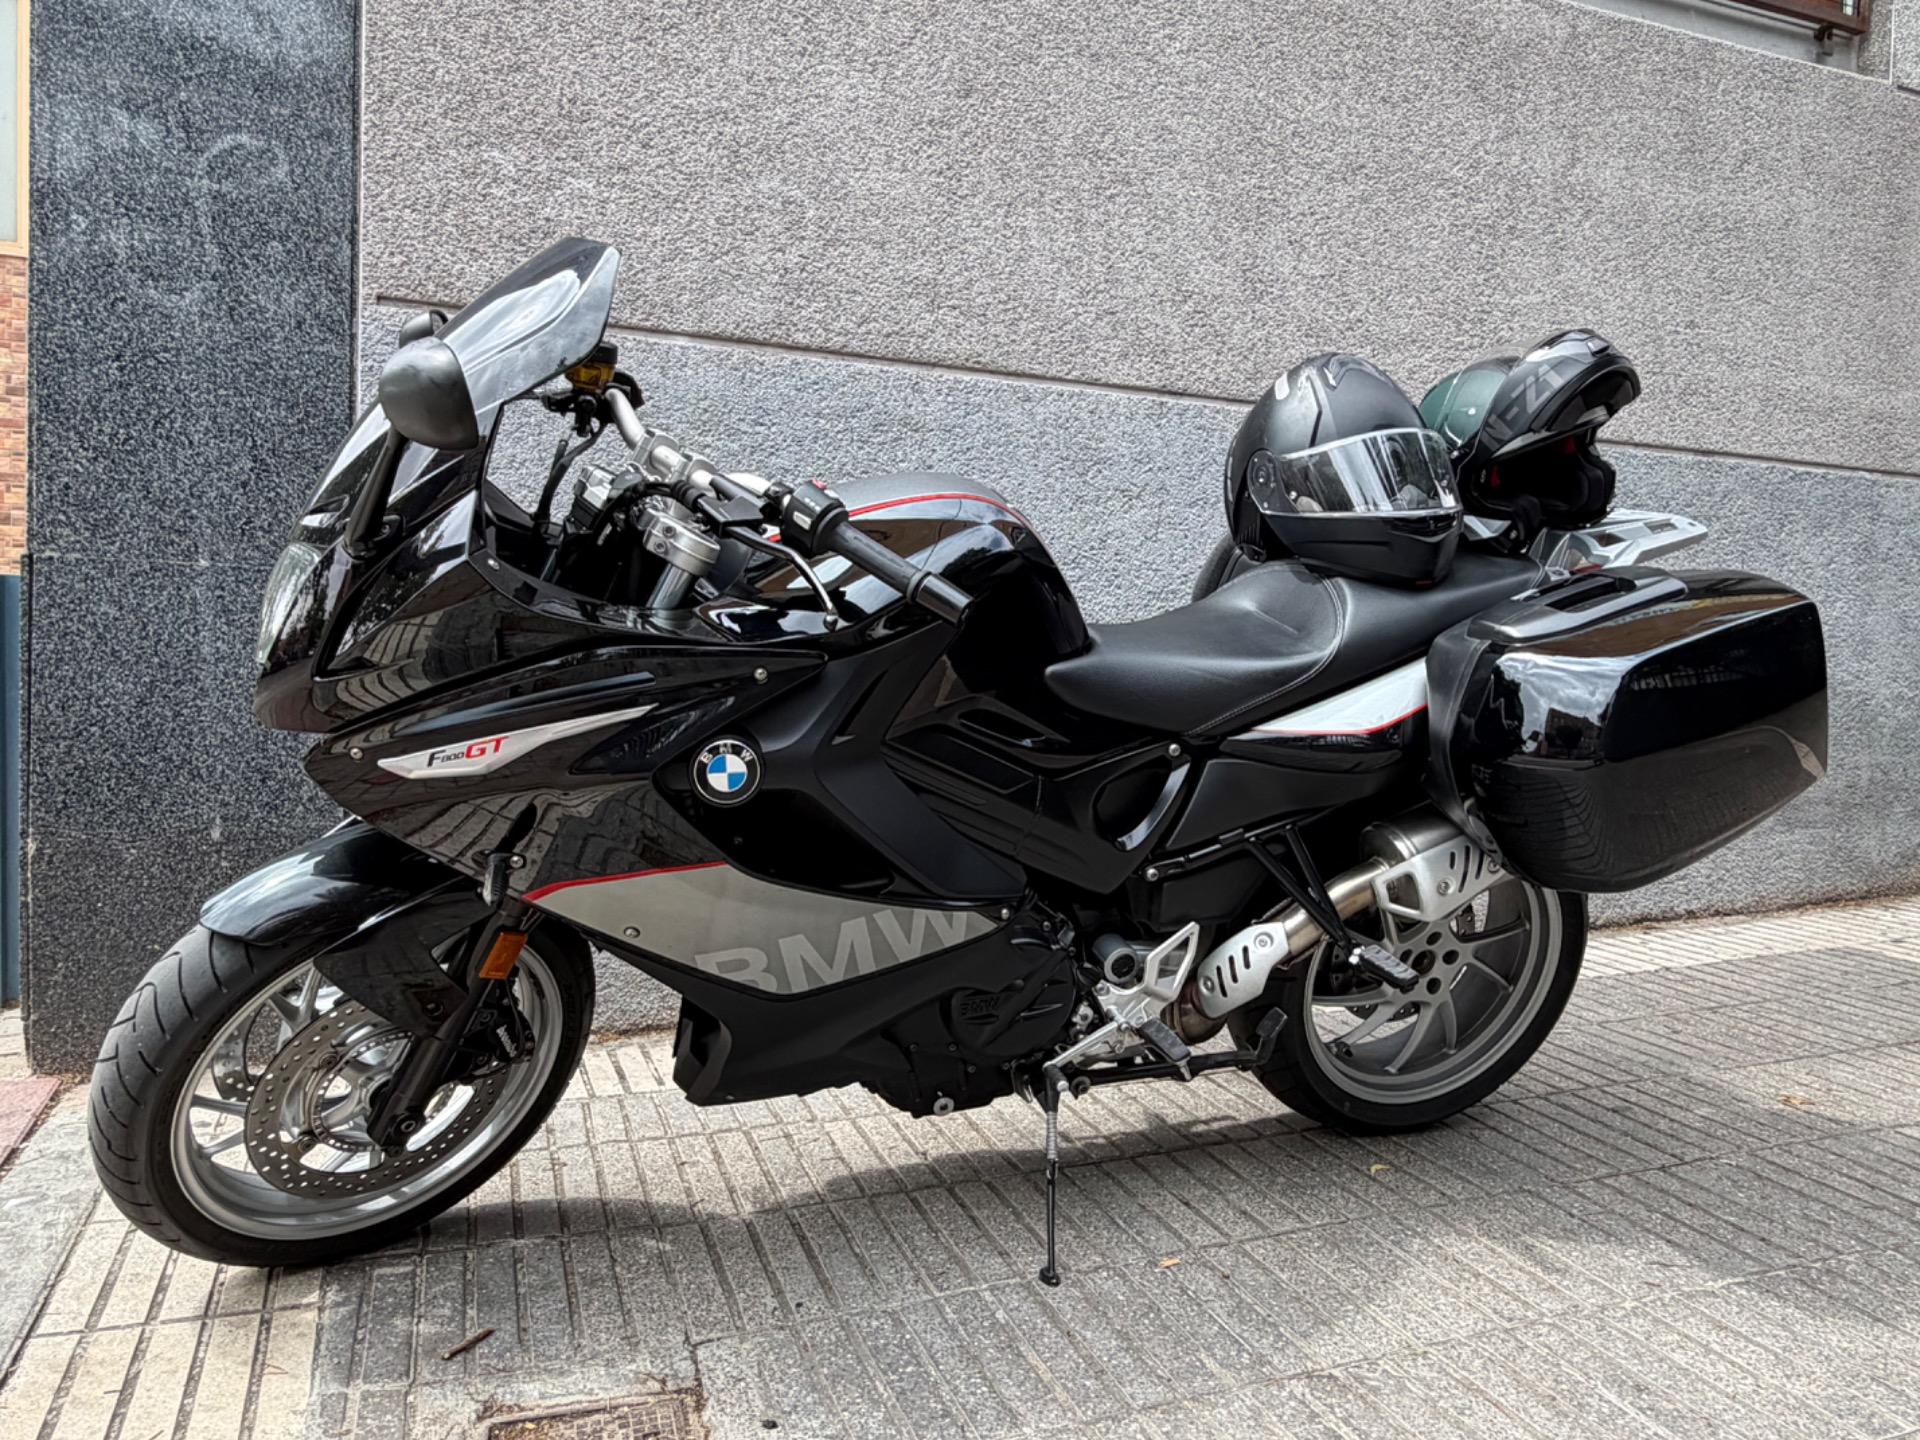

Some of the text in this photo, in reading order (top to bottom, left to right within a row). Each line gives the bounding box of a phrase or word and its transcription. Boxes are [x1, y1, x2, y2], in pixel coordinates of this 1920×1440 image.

[700, 742, 754, 764] BMW
[695, 909, 968, 993] BMW
[960, 996, 1000, 1016] BMW
